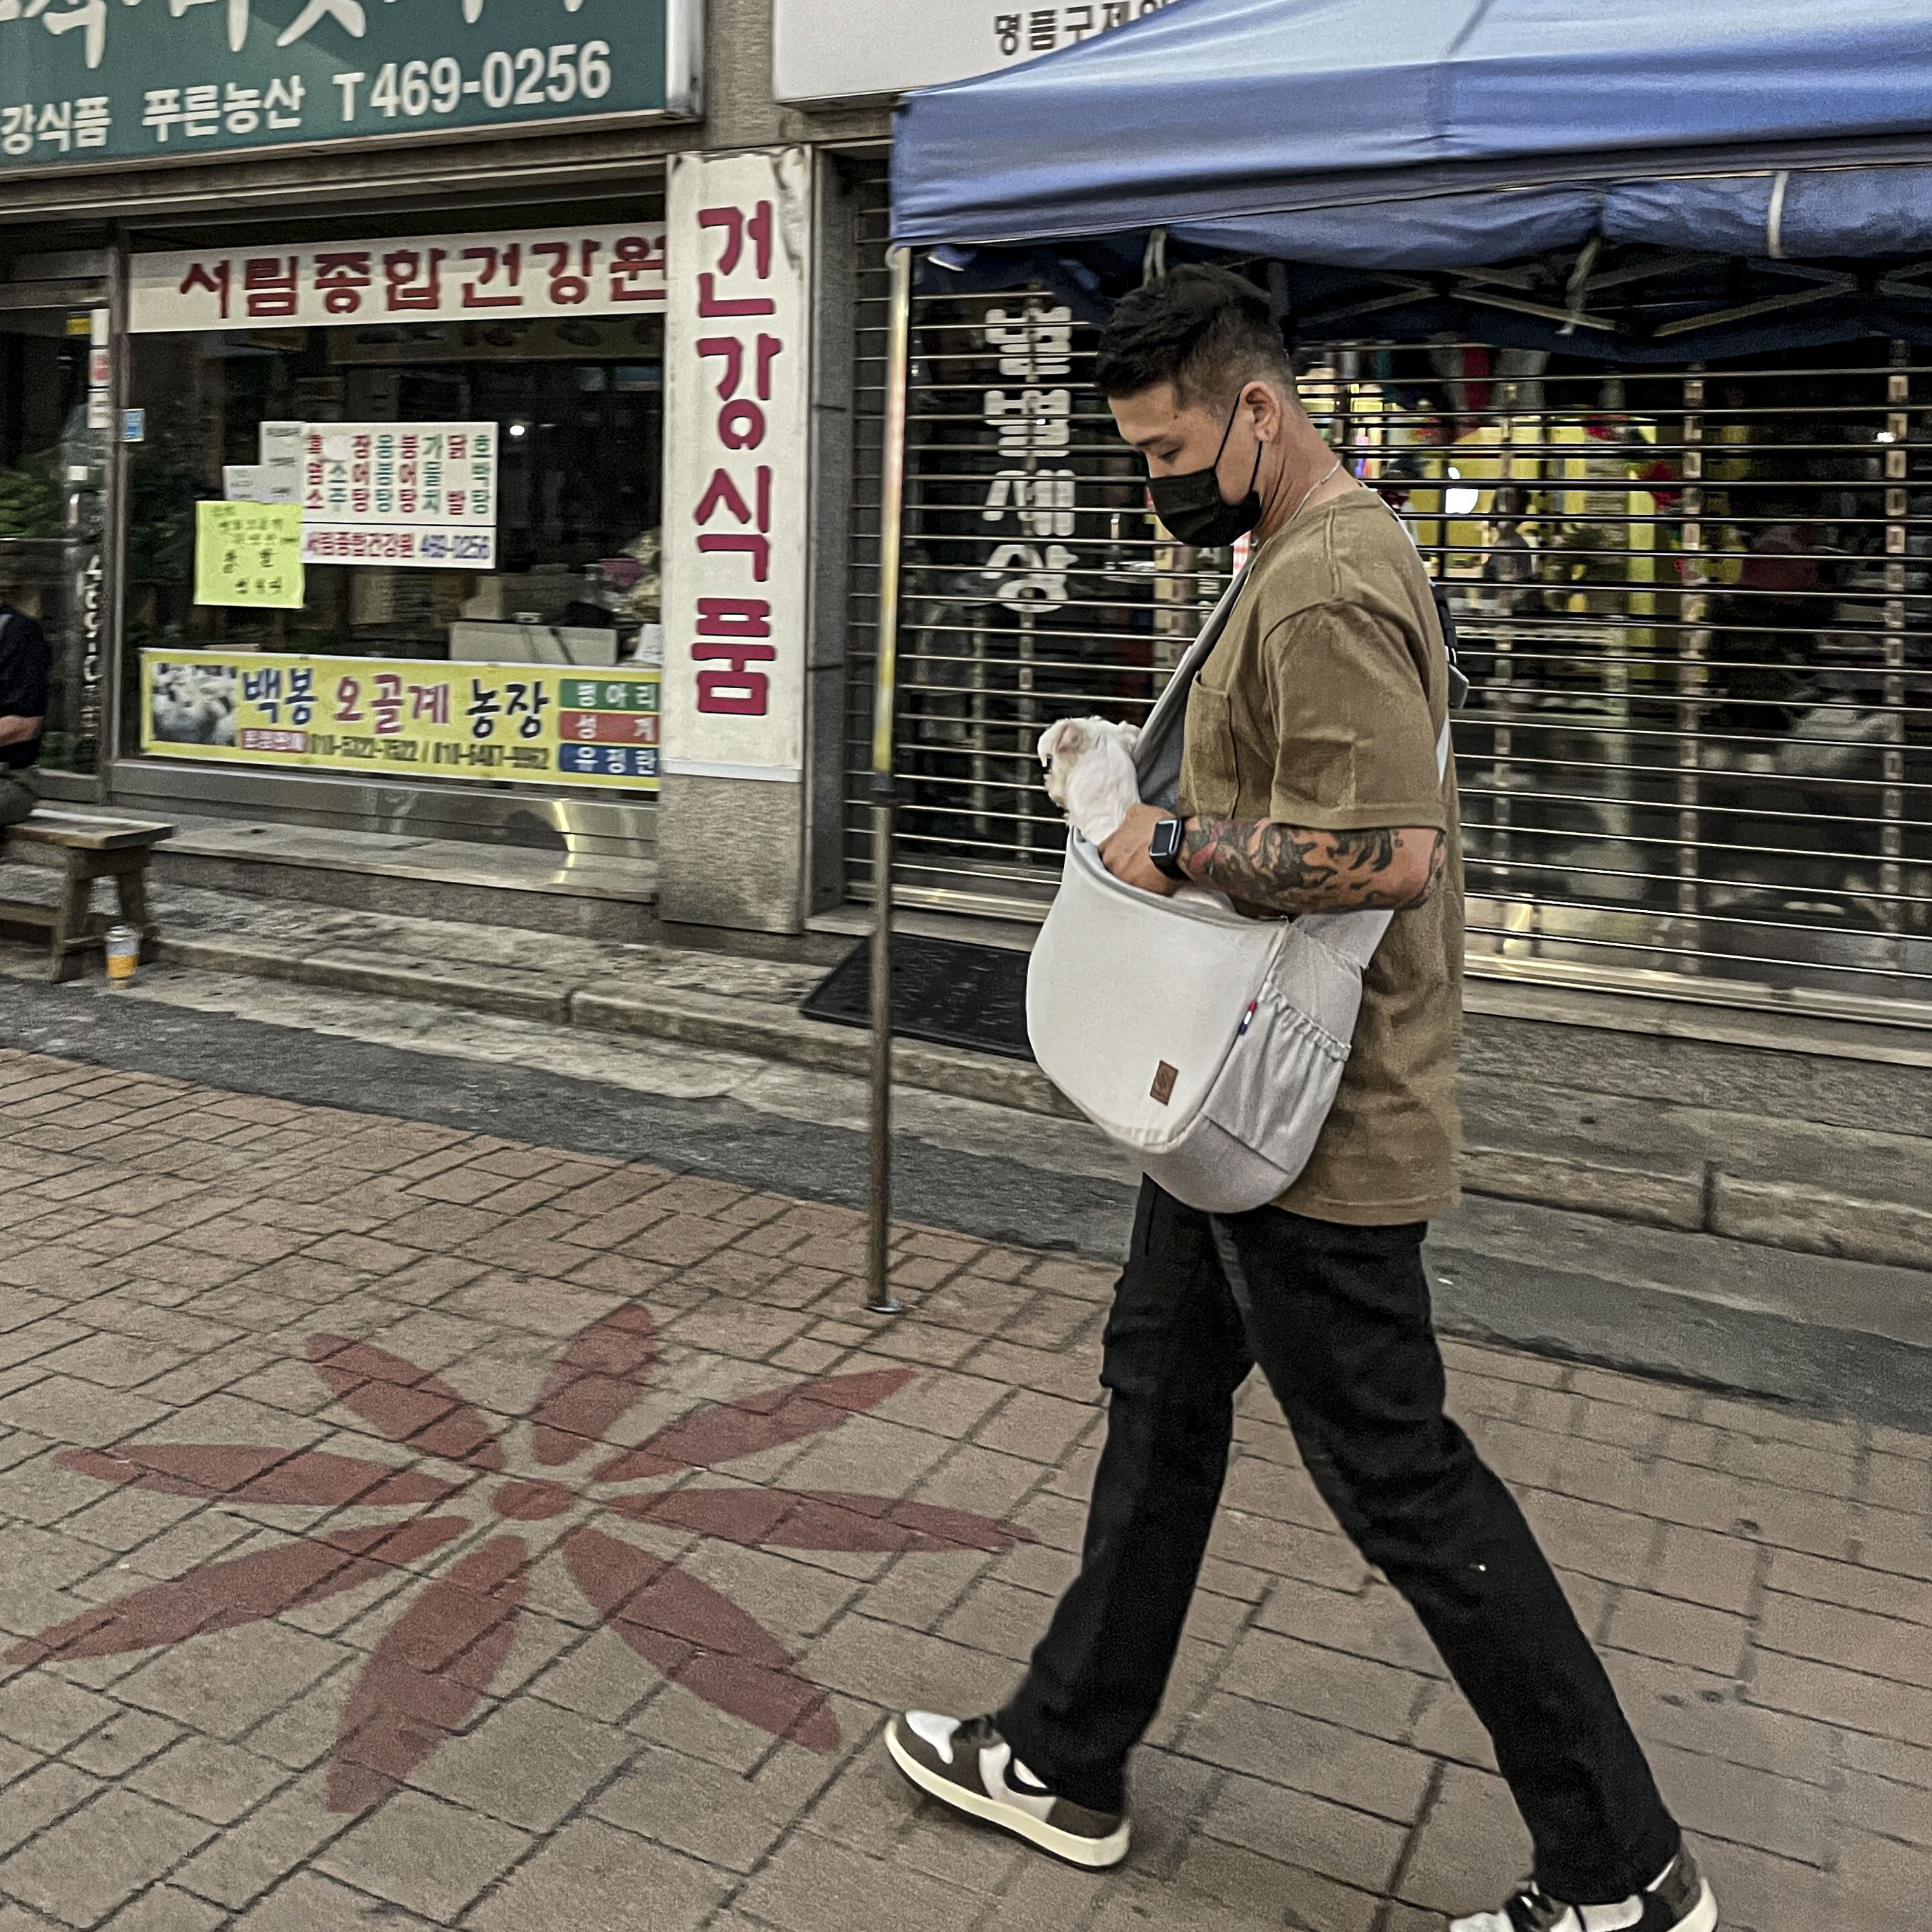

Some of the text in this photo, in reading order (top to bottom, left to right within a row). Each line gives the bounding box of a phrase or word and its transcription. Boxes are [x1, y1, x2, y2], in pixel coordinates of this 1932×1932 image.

[1, 96, 112, 155] 강식품
[142, 74, 306, 142] 푸른농산
[180, 237, 667, 319] 서림종합건강원
[691, 200, 781, 716] 건강식품
[980, 306, 1079, 612] 별별세상
[243, 668, 550, 738] 백봉 오골계 농장
[576, 681, 656, 710] 병아리
[574, 746, 657, 775] 유정란
